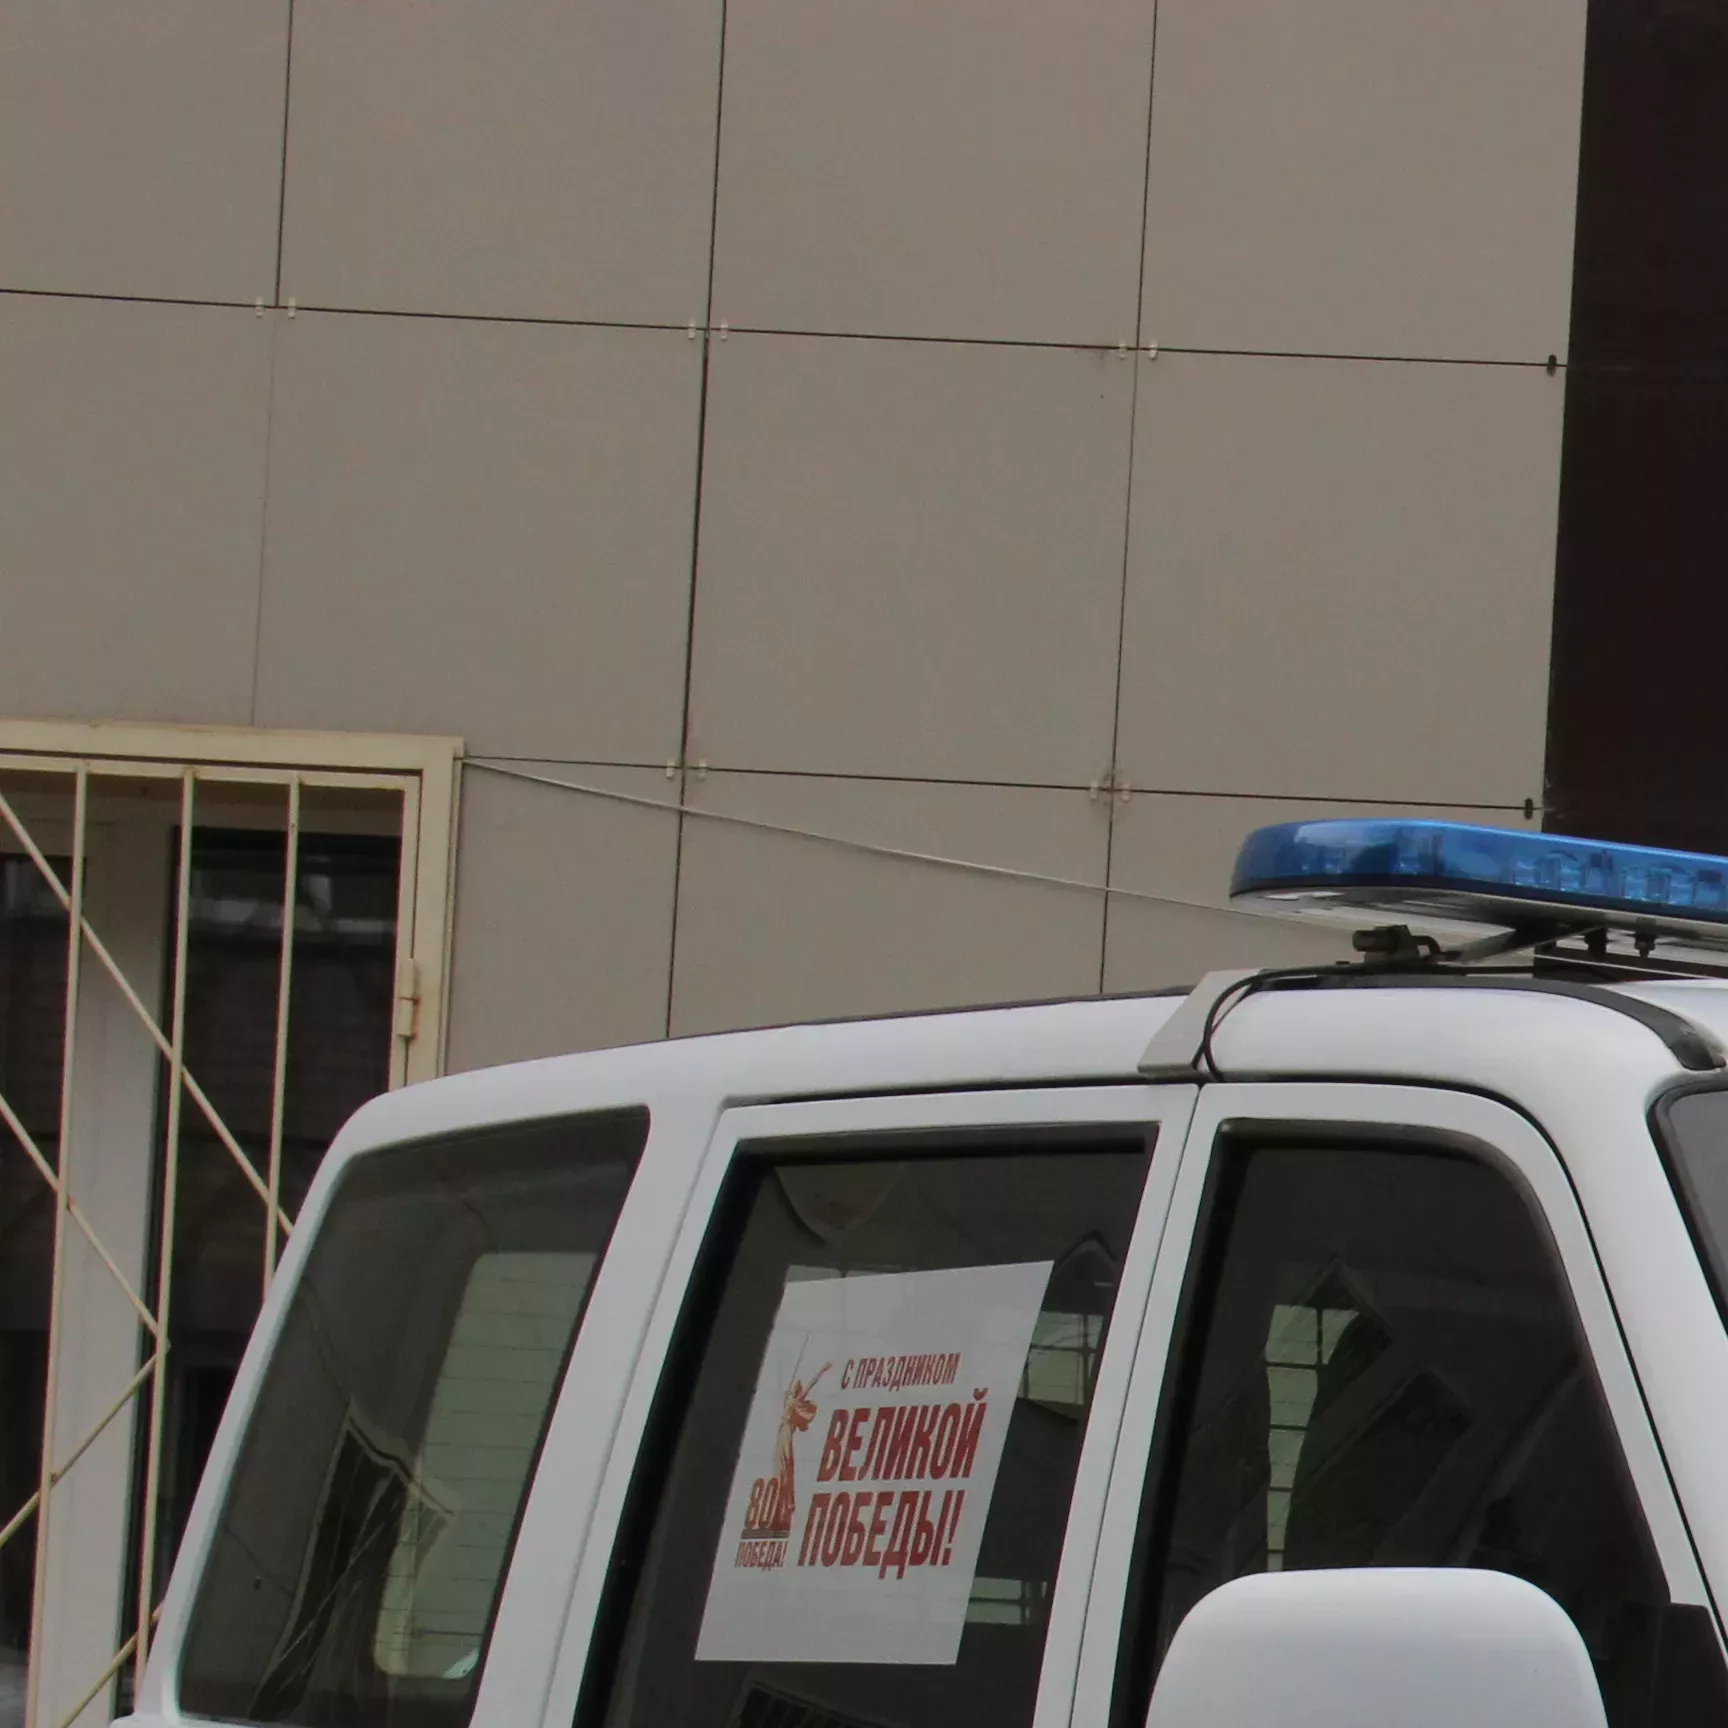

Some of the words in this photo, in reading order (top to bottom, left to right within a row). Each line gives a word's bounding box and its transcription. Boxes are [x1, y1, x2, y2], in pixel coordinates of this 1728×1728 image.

[841, 1358, 854, 1390] С
[852, 1352, 961, 1392] ПРАЗДНИКОМ
[816, 1388, 988, 1482] ВЕЛИКОЙ
[797, 1490, 965, 1580] ПОБЕДЫ!
